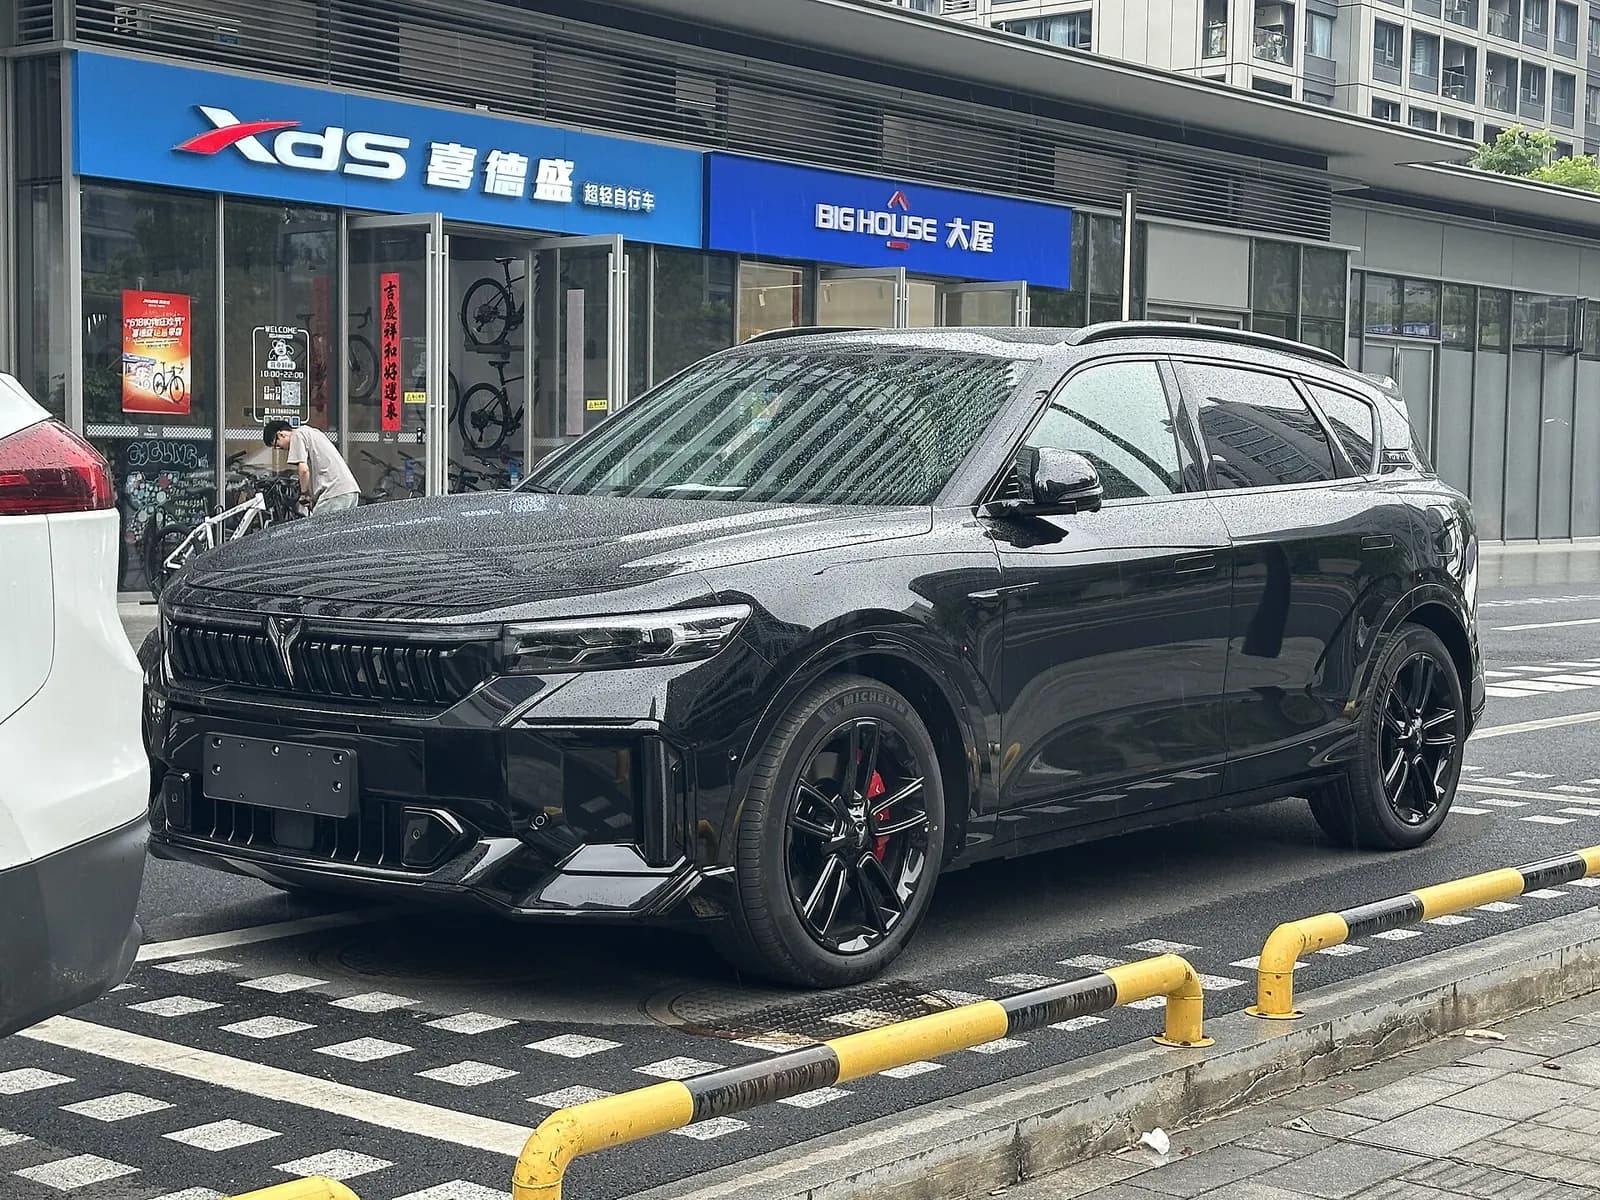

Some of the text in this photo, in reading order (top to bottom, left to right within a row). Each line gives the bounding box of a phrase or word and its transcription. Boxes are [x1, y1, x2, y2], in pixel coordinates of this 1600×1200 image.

[426, 142, 575, 202] 喜德盛
[583, 182, 656, 213] 超轻自行车
[815, 203, 994, 253] BIG HOUSE 大屋
[264, 325, 298, 335] WELCOME
[126, 440, 198, 469] CYCLING
[843, 691, 905, 713] MICHELIN
